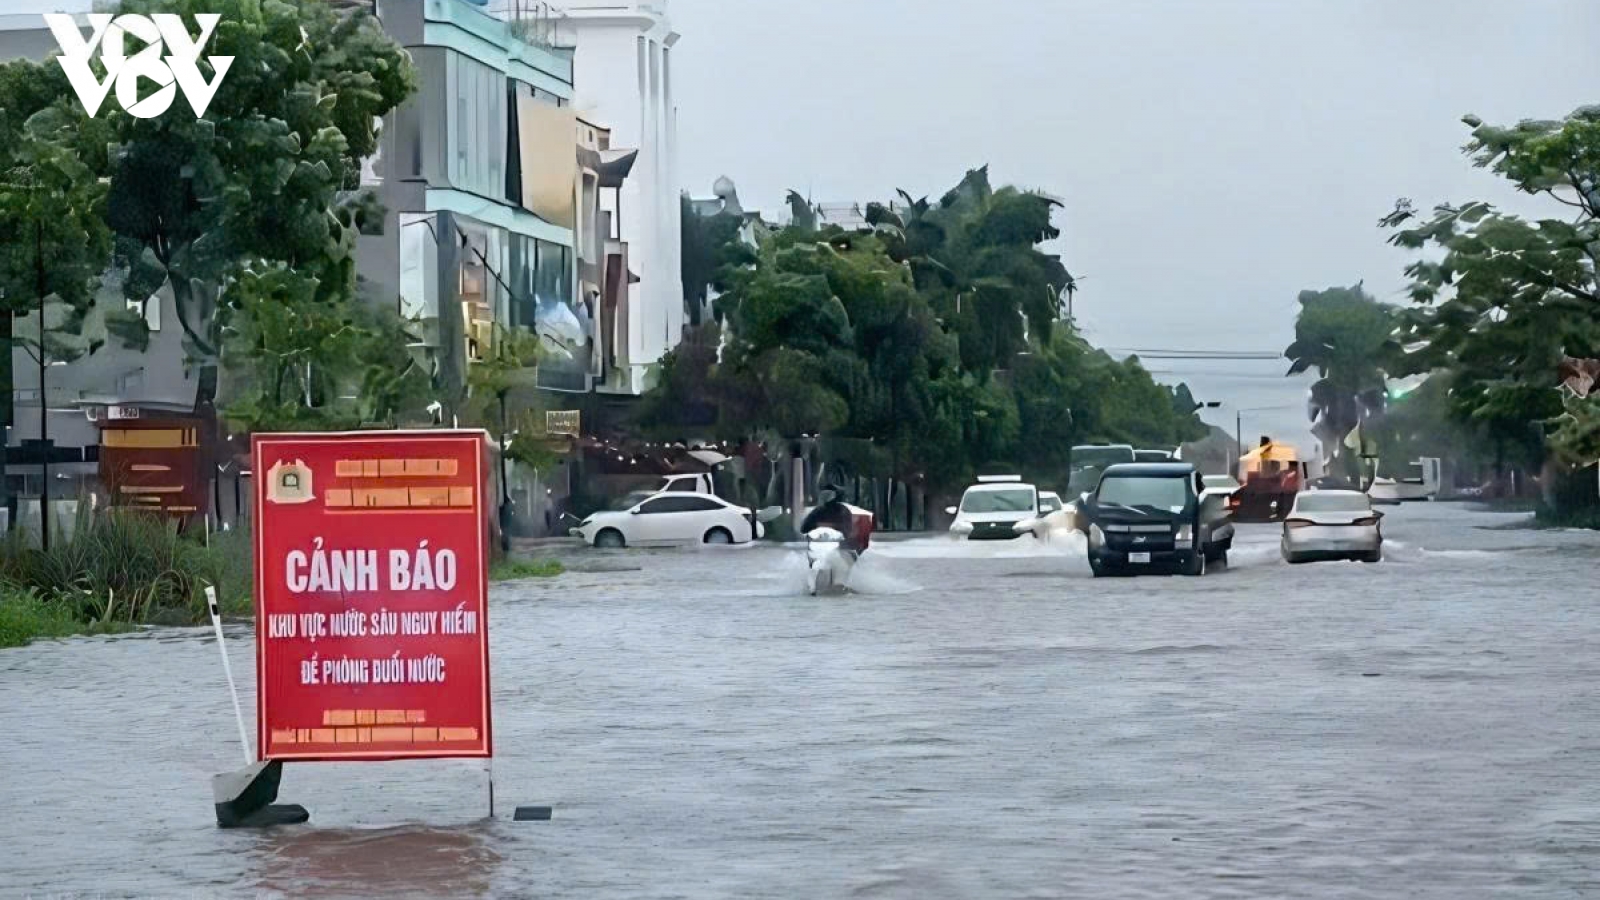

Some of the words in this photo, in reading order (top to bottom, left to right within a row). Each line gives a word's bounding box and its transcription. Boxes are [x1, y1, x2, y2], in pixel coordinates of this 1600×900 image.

[286, 536, 378, 593] CẢNH
[389, 539, 457, 591] BÁO
[268, 614, 296, 638] KHU
[300, 613, 326, 642] VỰC
[370, 607, 397, 636] SÂU
[401, 611, 438, 635] NGUY
[323, 654, 368, 685] PHÒNG
